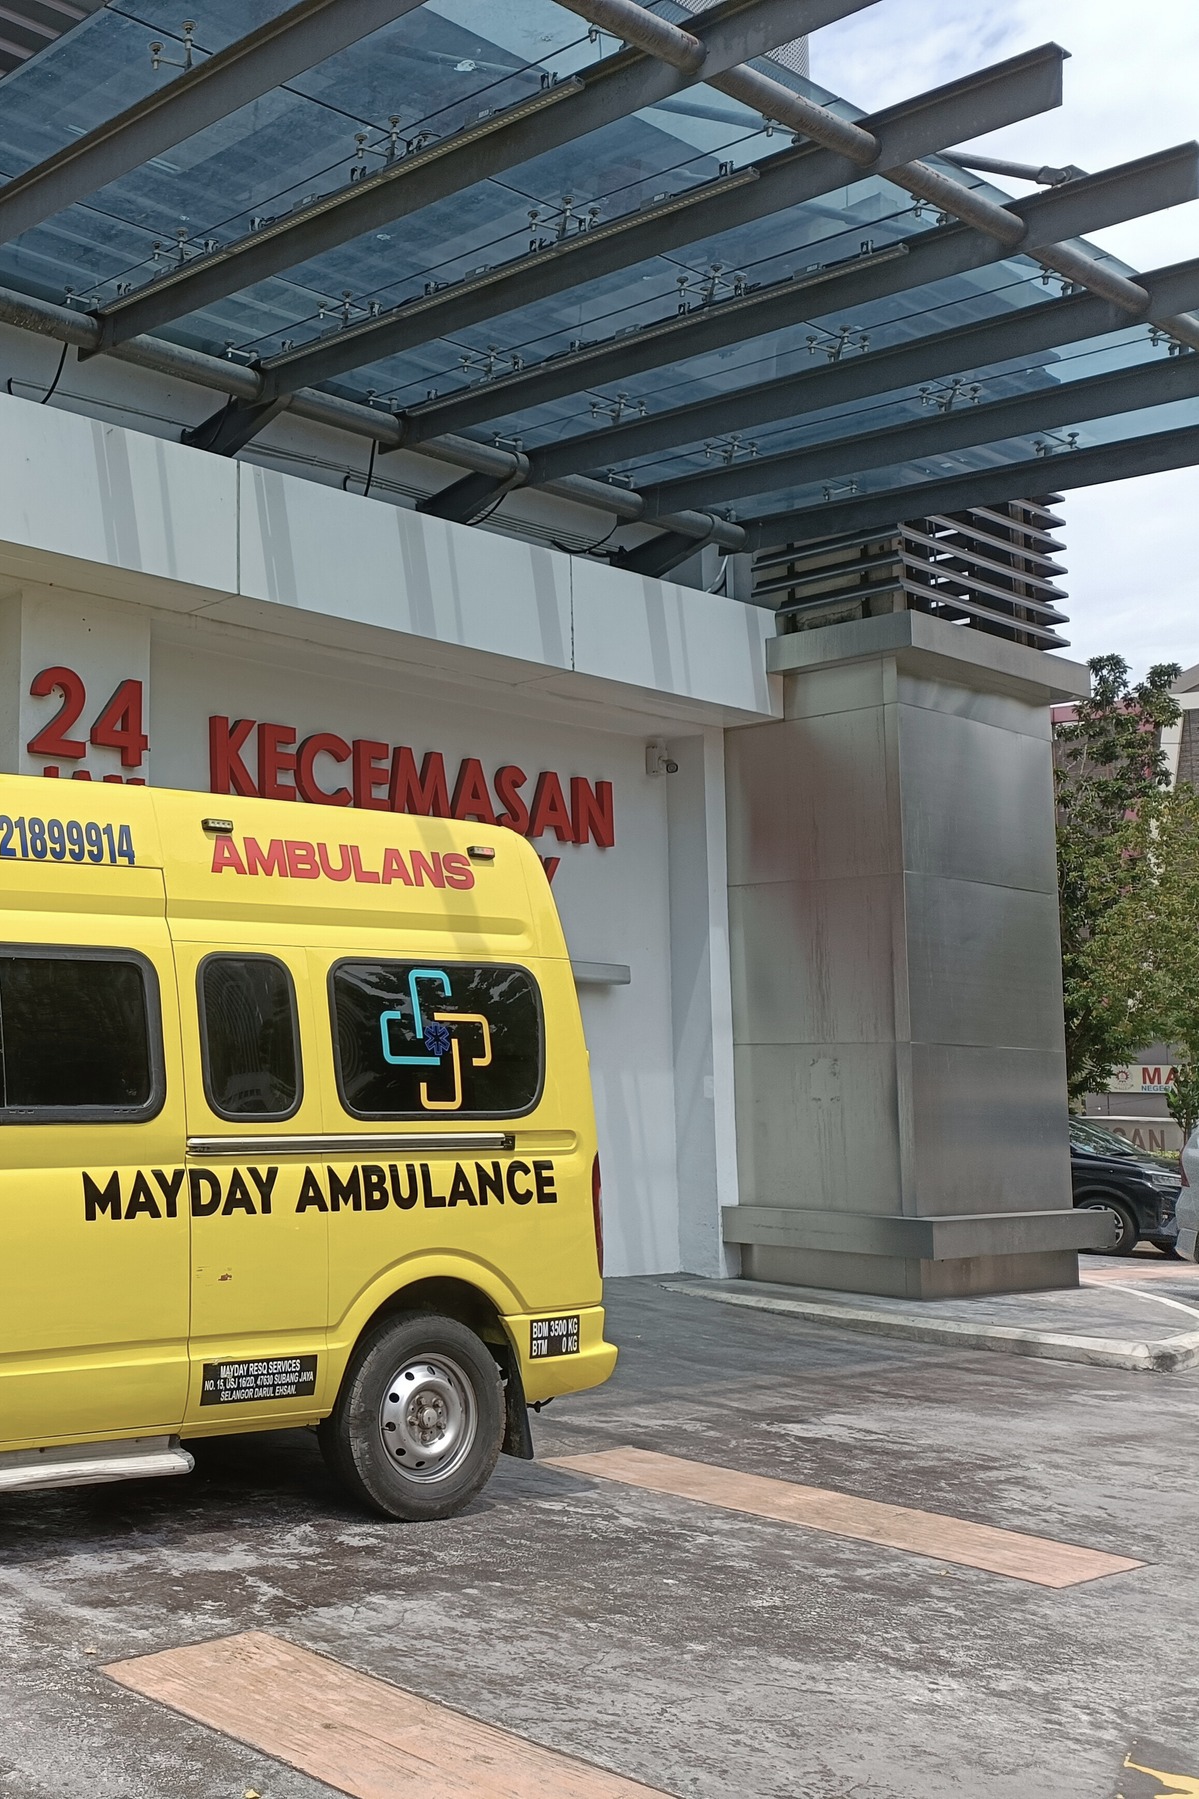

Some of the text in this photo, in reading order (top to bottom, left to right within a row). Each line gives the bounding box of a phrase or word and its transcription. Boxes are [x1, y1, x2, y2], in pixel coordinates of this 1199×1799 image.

[27, 666, 148, 767] 24
[209, 714, 615, 848] KECEMASAN
[211, 835, 476, 890] AMBULANS
[82, 1160, 557, 1221] MAYDAY AMBULANCE
[533, 1317, 578, 1338] BDM 3500 KG
[532, 1335, 578, 1356] BTM 0 KG
[220, 1359, 301, 1378] MAYDAY RESQ SERVICES
[204, 1380, 216, 1391] NO.
[217, 1379, 225, 1390] 15,
[225, 1378, 238, 1389] USJ
[256, 1375, 274, 1386] 47630
[274, 1372, 299, 1384] SUBANG
[299, 1371, 314, 1382] JAYA
[220, 1384, 297, 1401] SELANGOR DARUL EHSAN.
